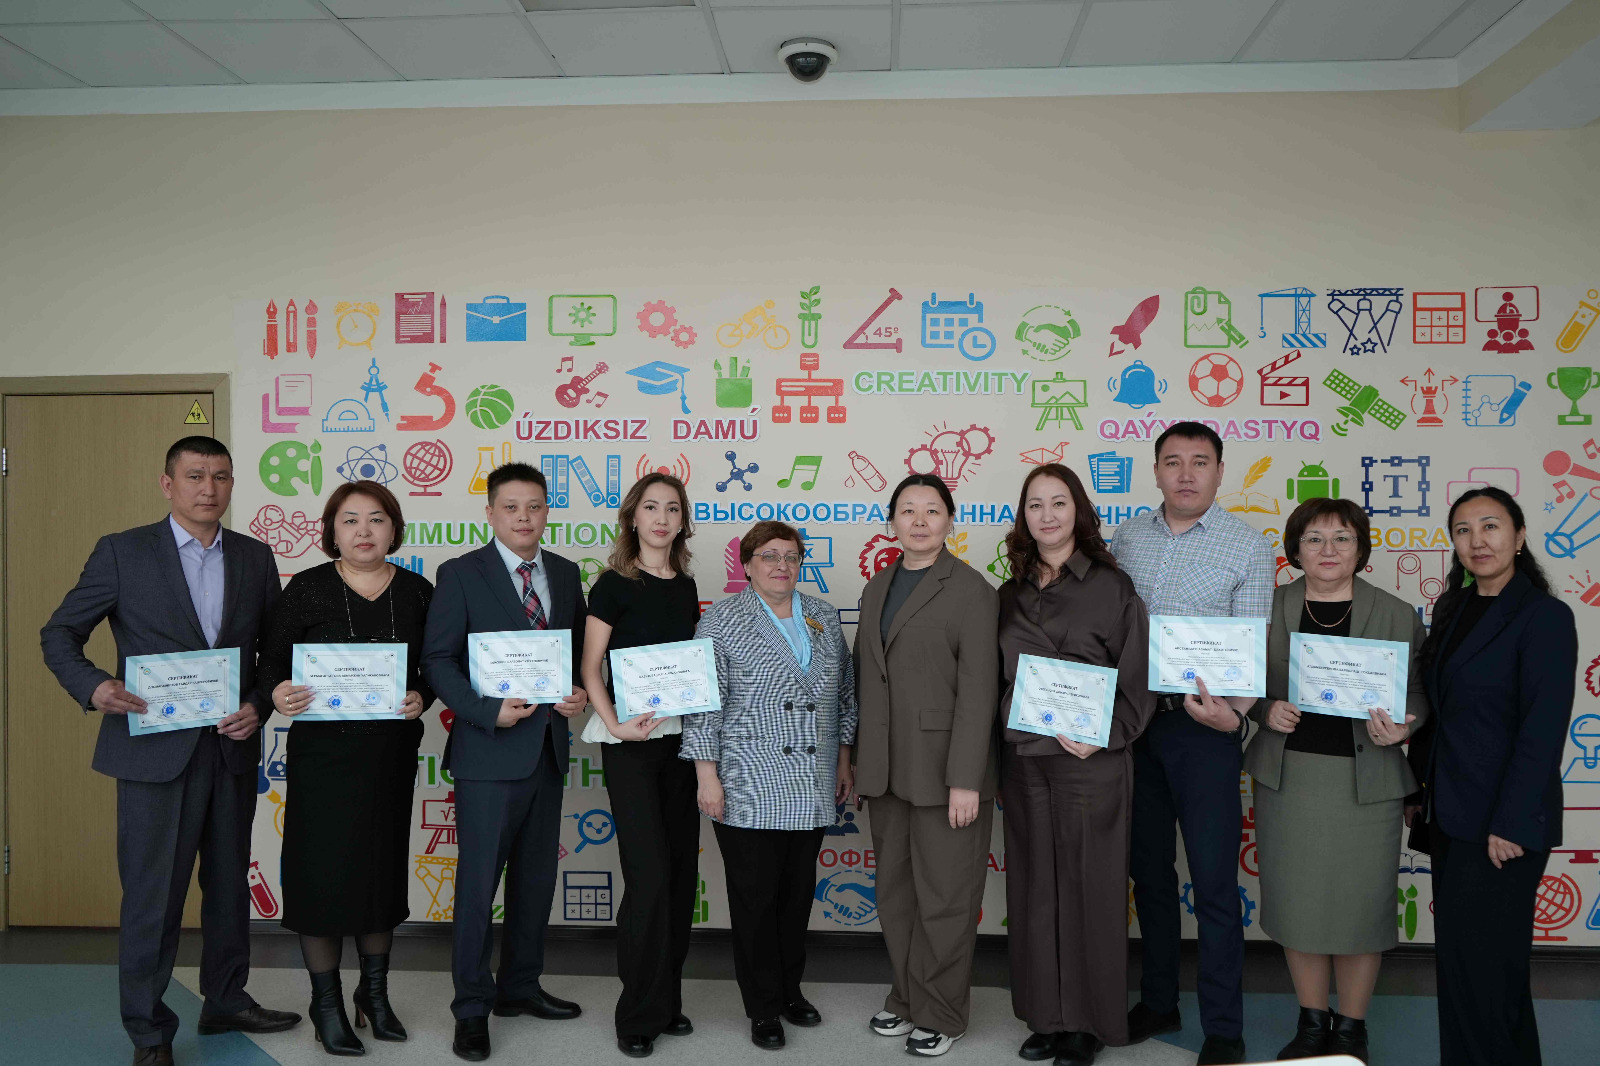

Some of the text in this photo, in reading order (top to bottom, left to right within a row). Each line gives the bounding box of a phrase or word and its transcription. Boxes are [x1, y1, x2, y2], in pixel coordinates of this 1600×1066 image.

[854, 371, 1029, 393] CREATIVITY
[516, 407, 758, 441] ÚZDIKSIZ DAMÚ
[1100, 412, 1320, 441] QAÝYDASTYQ
